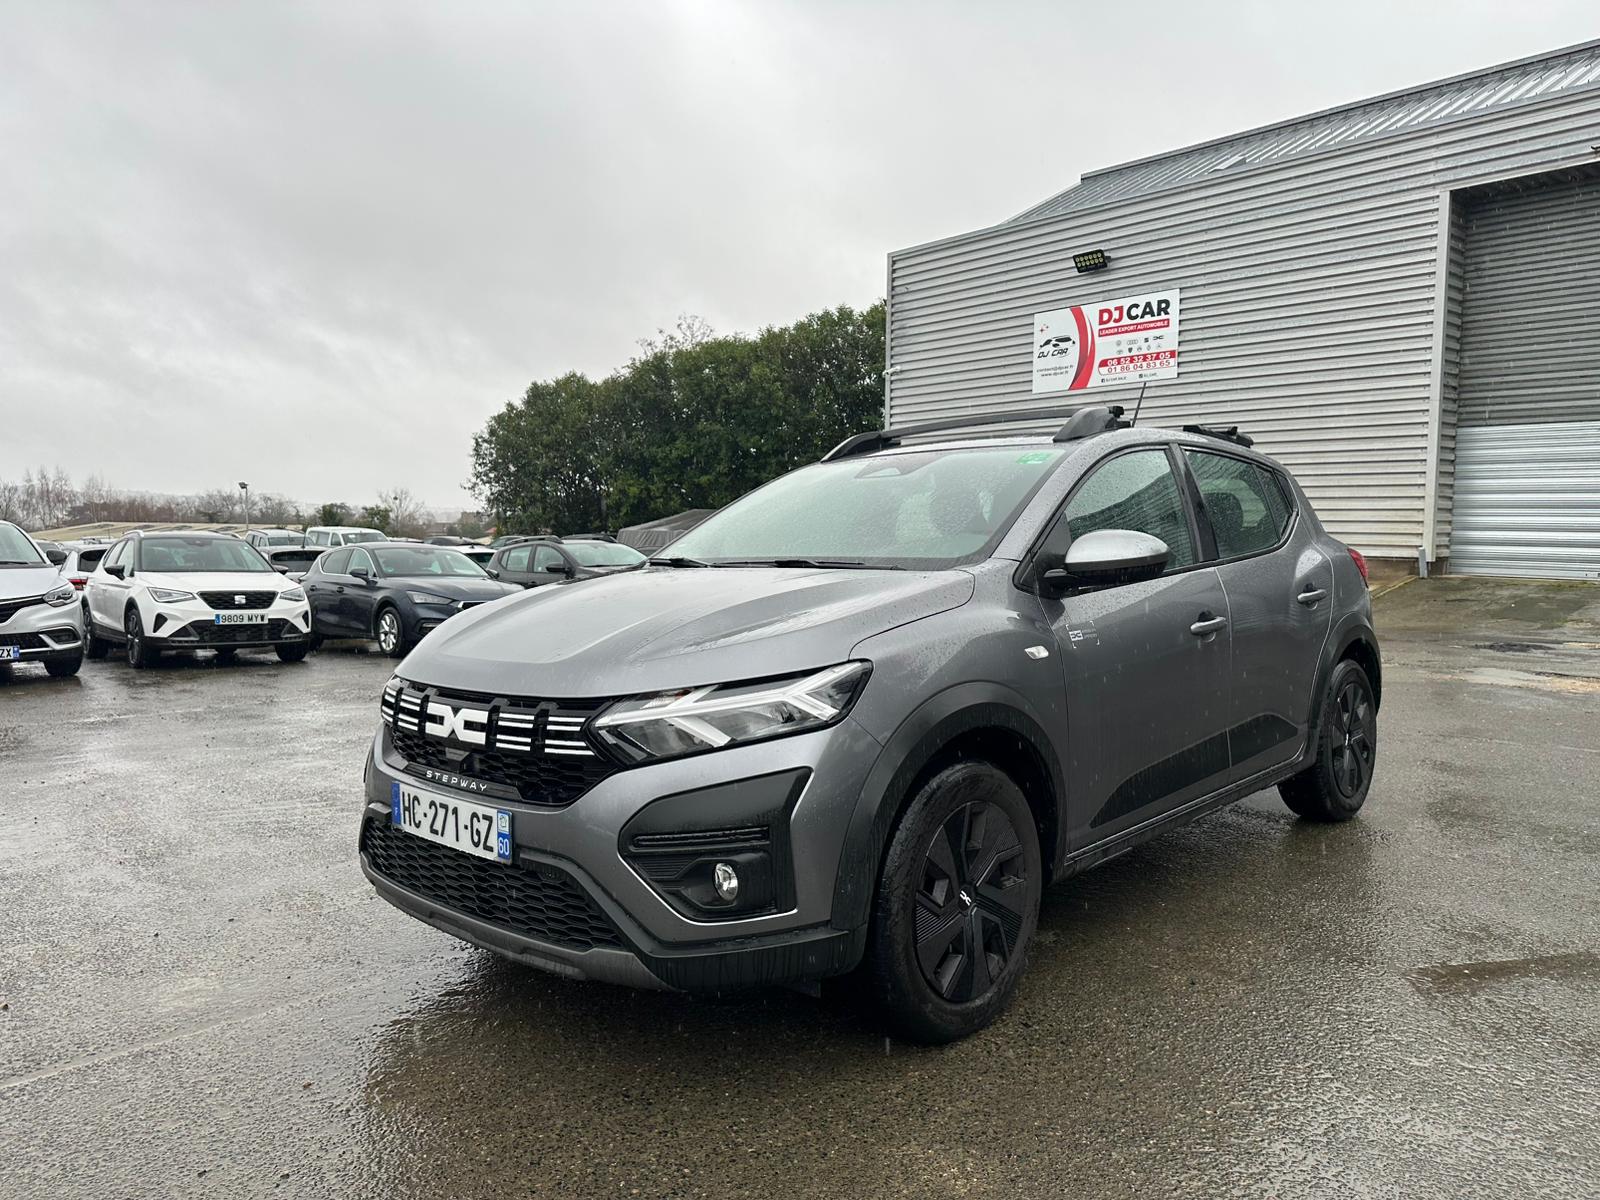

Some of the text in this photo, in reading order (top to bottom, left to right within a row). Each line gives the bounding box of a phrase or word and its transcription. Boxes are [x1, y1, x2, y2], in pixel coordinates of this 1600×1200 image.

[1099, 299, 1171, 326] DJ CAR
[1099, 320, 1169, 336] LEADER EXPORT AUTOMOBILE
[1107, 352, 1171, 367] 06 52 32 37 05
[1107, 359, 1171, 374] 01 86 04 83 65
[221, 614, 244, 624] 9809
[426, 770, 488, 792] STEPWAY
[402, 791, 511, 856] HC-271-GZ 60
